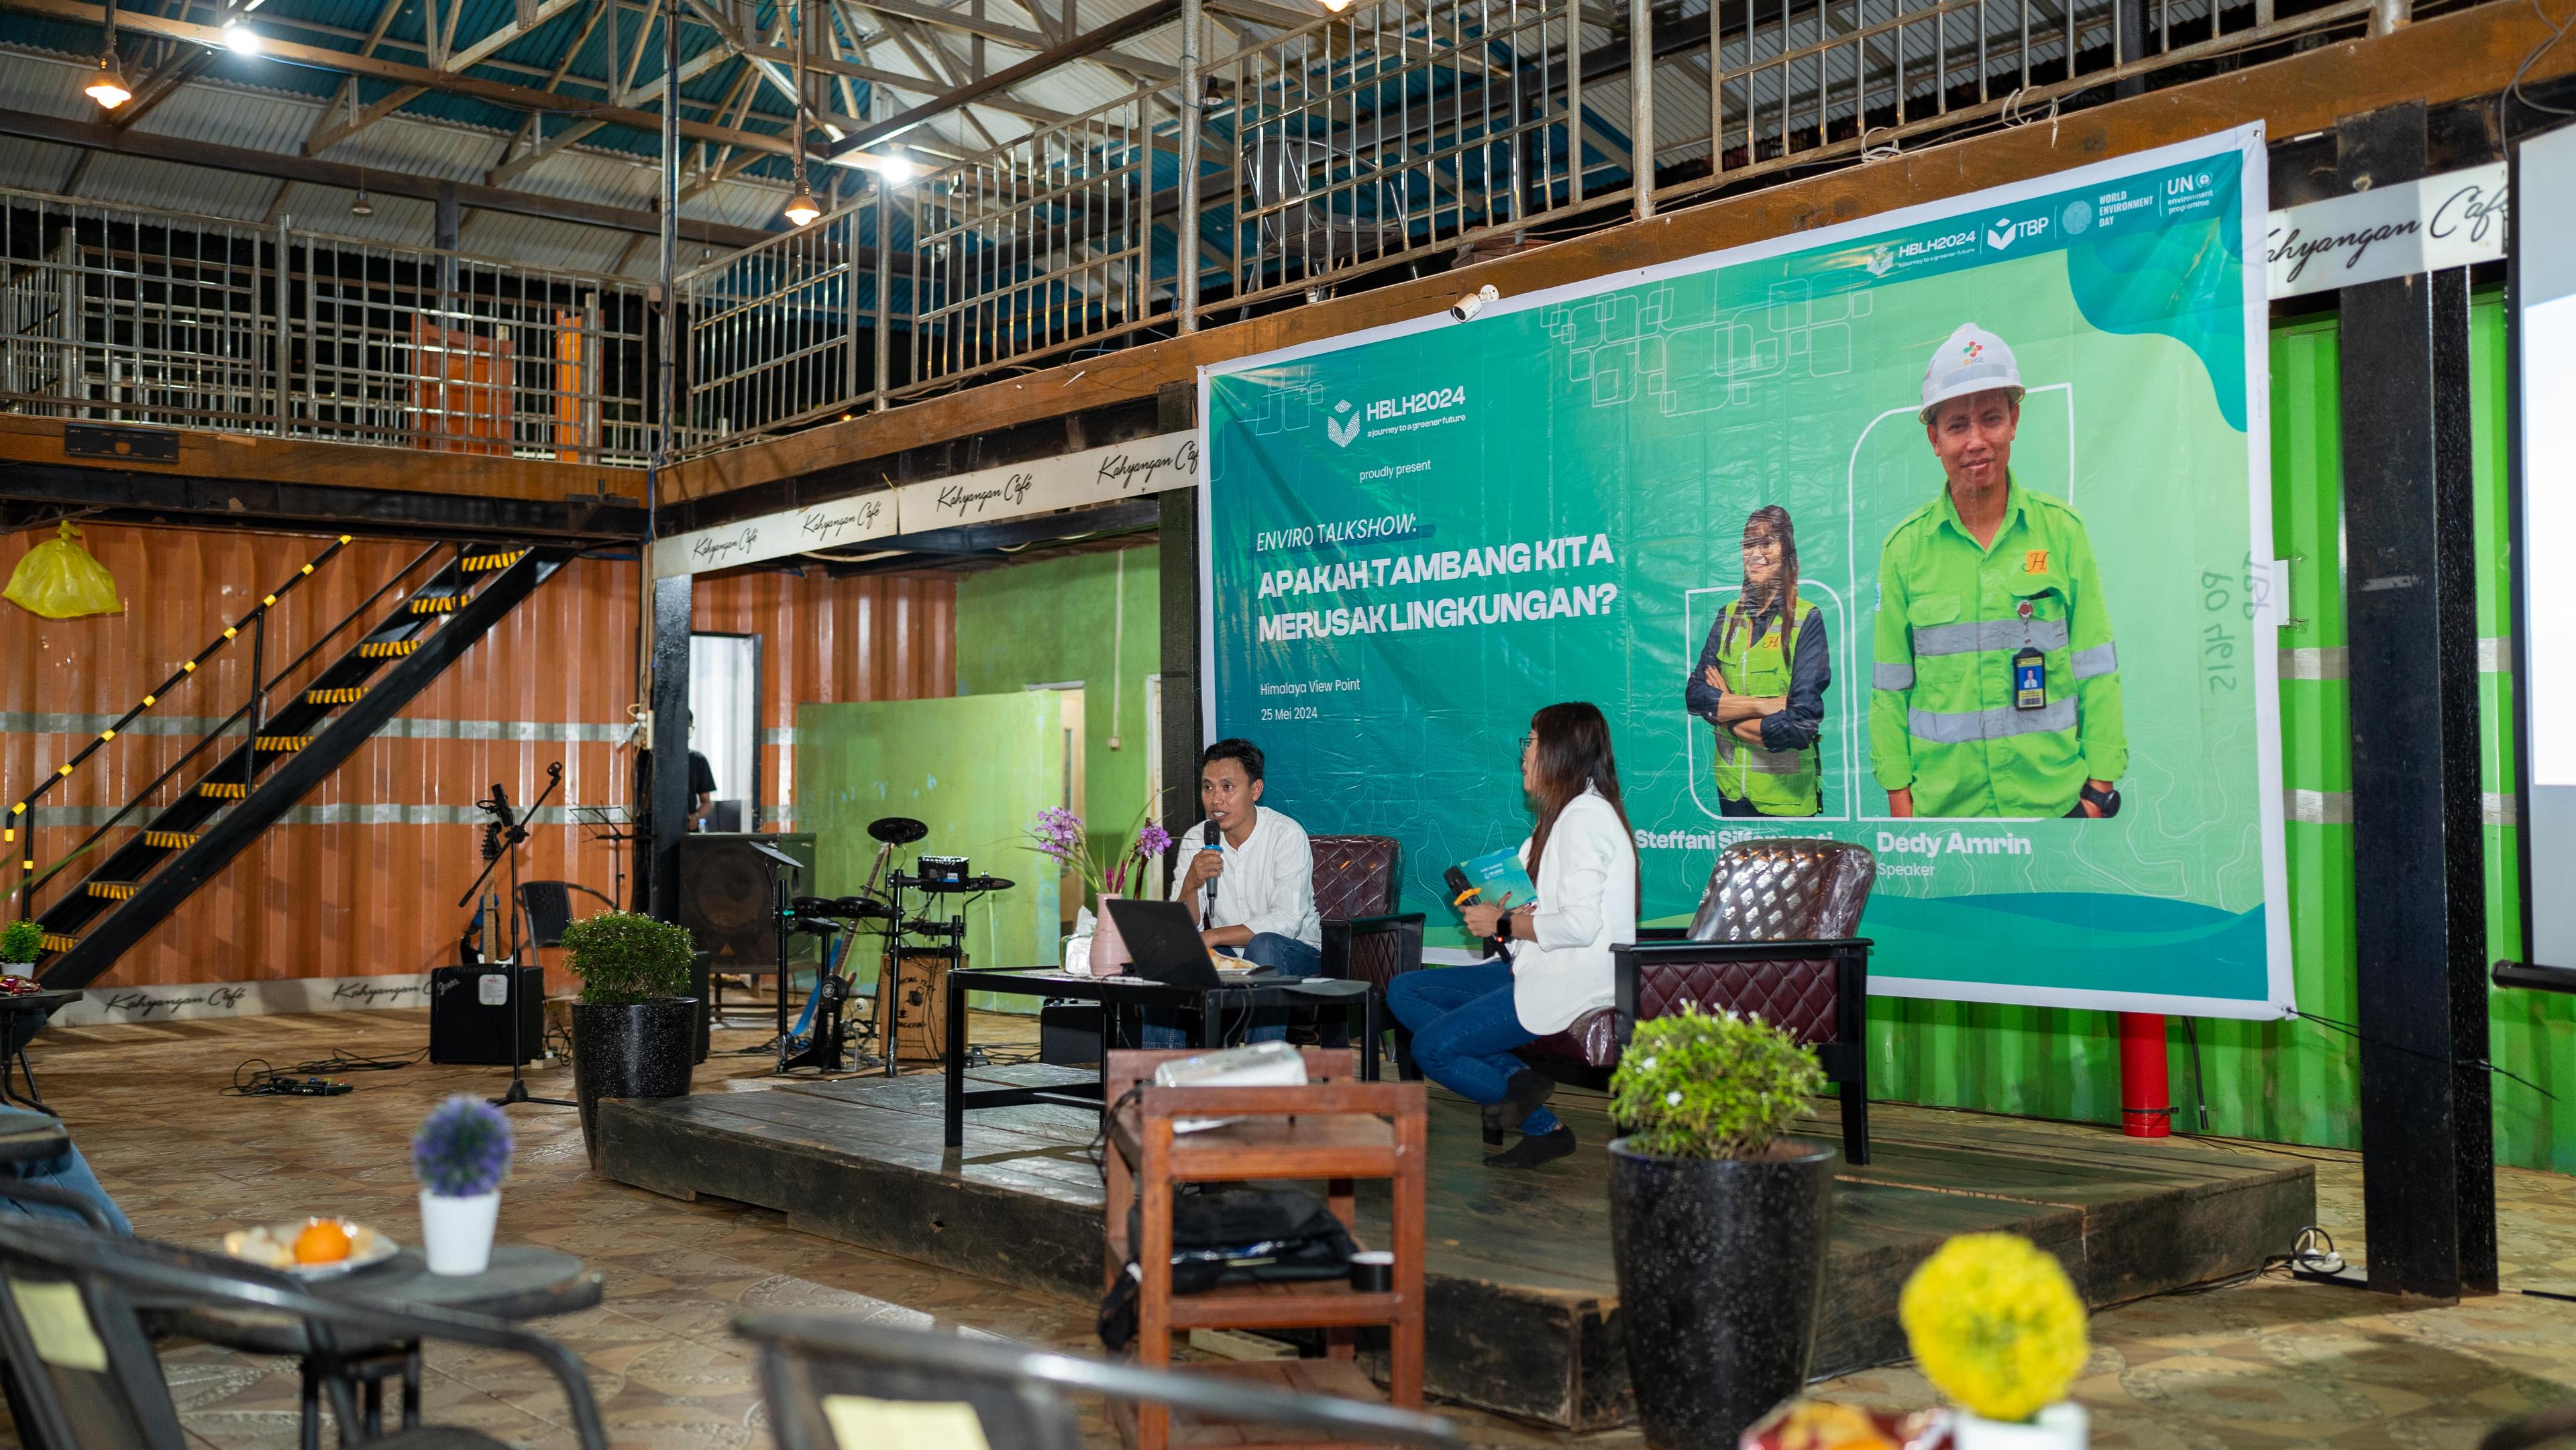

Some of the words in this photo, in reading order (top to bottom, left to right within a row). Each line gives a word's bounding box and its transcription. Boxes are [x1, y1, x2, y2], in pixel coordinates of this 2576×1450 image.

[2167, 175, 2193, 195] UN
[2099, 191, 2127, 205] WORLD
[2099, 195, 2153, 216] ENVIRONMENT
[2167, 189, 2213, 205] environment
[2168, 199, 2210, 215] programme
[2099, 215, 2114, 228] DAY
[2430, 183, 2508, 243] Caf
[2018, 217, 2049, 236] TBP
[1898, 230, 1976, 258] HBLH2024
[1902, 259, 1923, 268] journey
[1934, 252, 1957, 262] greener
[1957, 248, 1975, 256] future
[1366, 385, 1466, 421] HBLH2024
[1372, 426, 1399, 438] journey
[1412, 419, 1442, 431] greener
[1442, 415, 1466, 424] future
[1097, 455, 1173, 488] Kahyangan
[1175, 440, 1199, 474] Caf
[1360, 465, 1394, 484] proudly
[1396, 460, 1432, 478] present
[936, 485, 1002, 517] Kahyangan
[1004, 473, 1032, 505] Café
[802, 513, 856, 541] Kahyangan
[857, 501, 881, 529] Café
[692, 537, 738, 564] Kahyangan
[739, 527, 759, 554] Café
[1256, 526, 1314, 552] ENVIRO
[1258, 560, 1368, 599] APAKAH
[1371, 543, 1530, 586] TAMBANG
[1535, 533, 1615, 570] KITA
[1258, 605, 1389, 642] MERUSAK
[1390, 582, 1617, 632] LINGKUNGAN?
[1260, 682, 1307, 697] Himalaya
[1309, 680, 1333, 693] View
[1335, 678, 1360, 691] Point
[1261, 709, 1273, 721] 25
[1275, 707, 1292, 720] Mei
[1294, 707, 1318, 719] 2024
[1634, 829, 1715, 850] Steffani
[1878, 831, 1940, 858] Dedy
[1945, 832, 2031, 855] Amrin
[1878, 862, 1935, 880] Speaker
